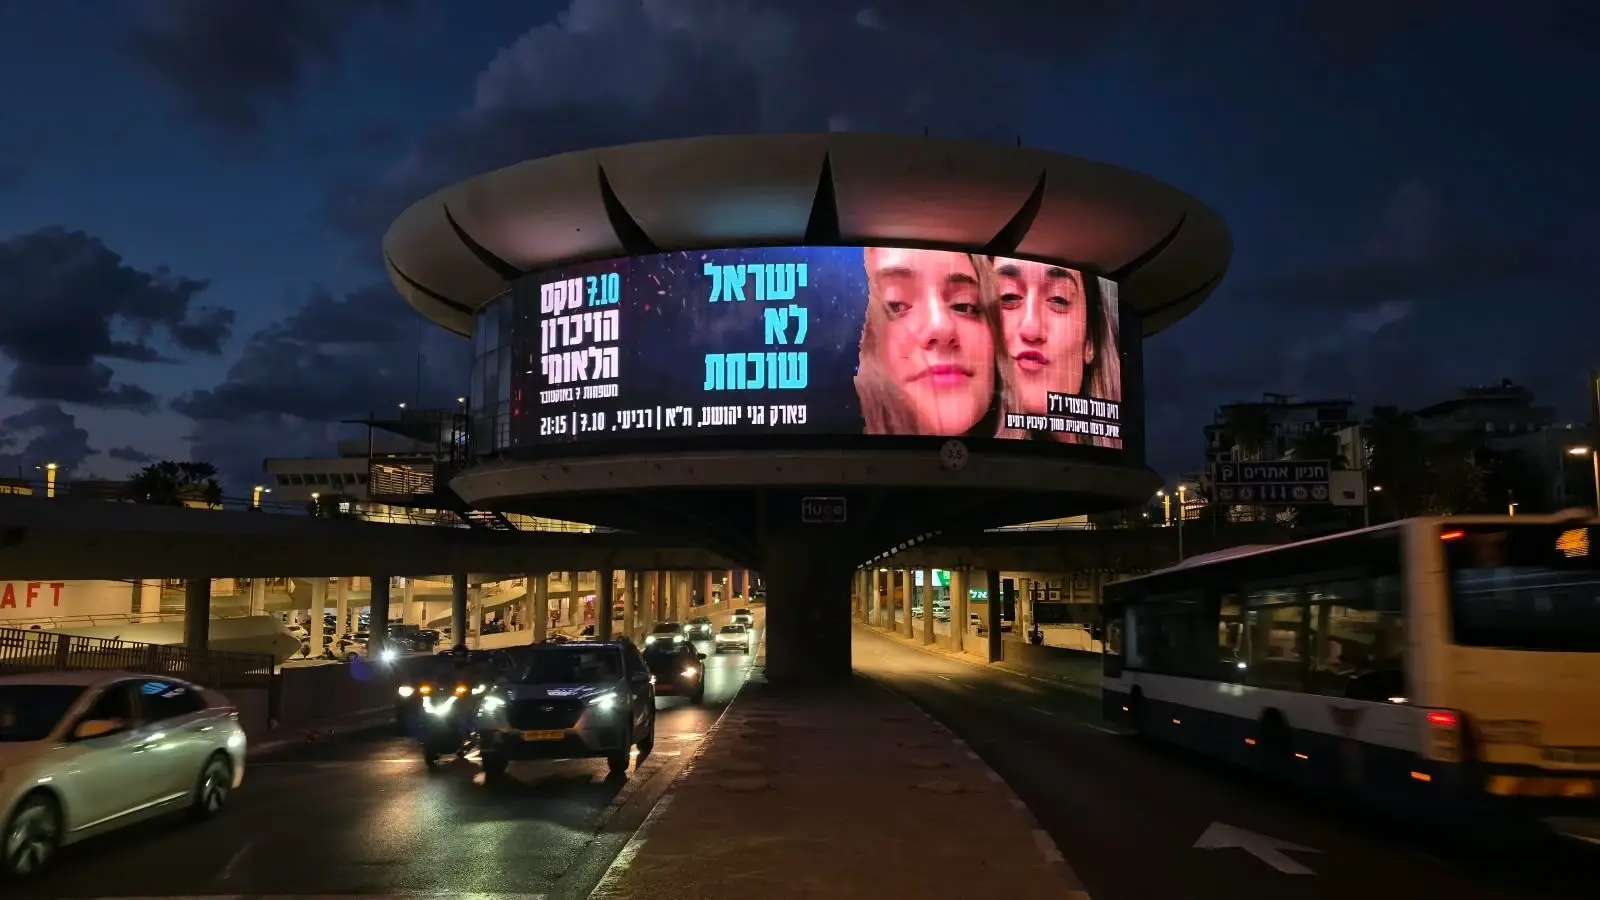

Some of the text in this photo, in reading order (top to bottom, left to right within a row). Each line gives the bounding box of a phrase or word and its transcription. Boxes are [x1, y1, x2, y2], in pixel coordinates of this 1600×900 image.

[704, 262, 808, 302] ישראל
[540, 273, 620, 316] 7.10 טקס
[540, 309, 619, 354] הזיכרון
[764, 304, 808, 345] לא
[540, 346, 619, 385] הלאומי
[704, 352, 808, 391] שוכחת
[540, 384, 618, 404] משפחות 7 באוקטובר
[540, 415, 567, 436] 21:15
[580, 412, 605, 432] 7.10
[697, 406, 742, 427] יהושע,
[747, 405, 765, 425] גני
[770, 405, 807, 427] פארק
[1244, 466, 1288, 479] אתרים
[1294, 466, 1324, 481] חניון
[0, 583, 65, 609] AFT
